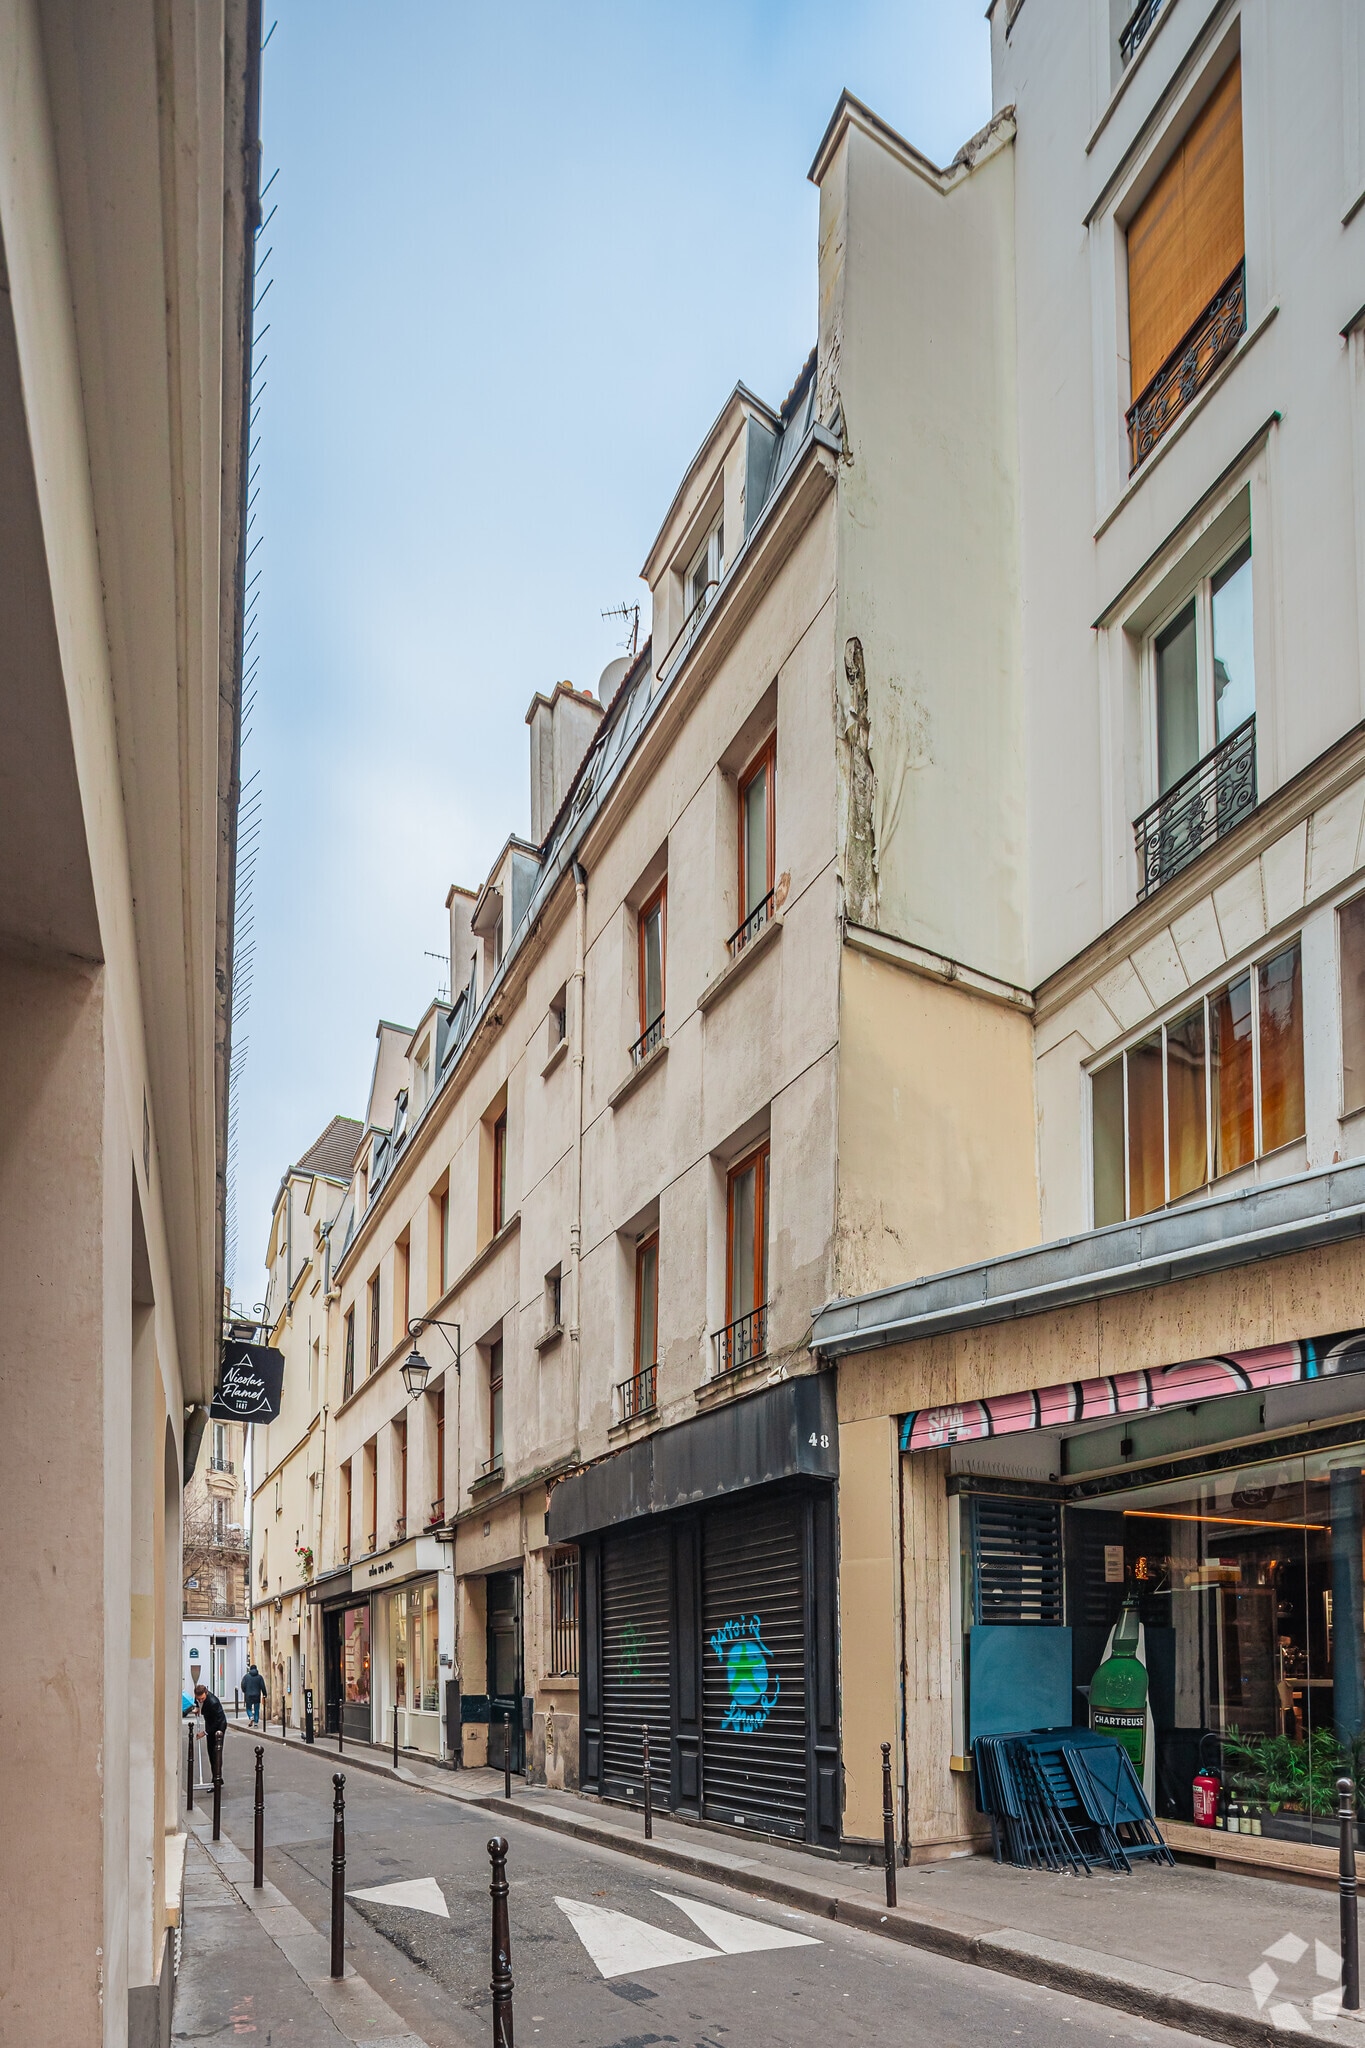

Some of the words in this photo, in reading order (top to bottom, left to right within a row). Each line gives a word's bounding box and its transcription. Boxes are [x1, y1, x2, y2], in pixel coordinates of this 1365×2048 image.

[223, 1367, 264, 1386] Nicolas
[222, 1383, 265, 1400] Flamel
[808, 1432, 830, 1449] 48
[1094, 1715, 1144, 1726] CHARTREUSE
